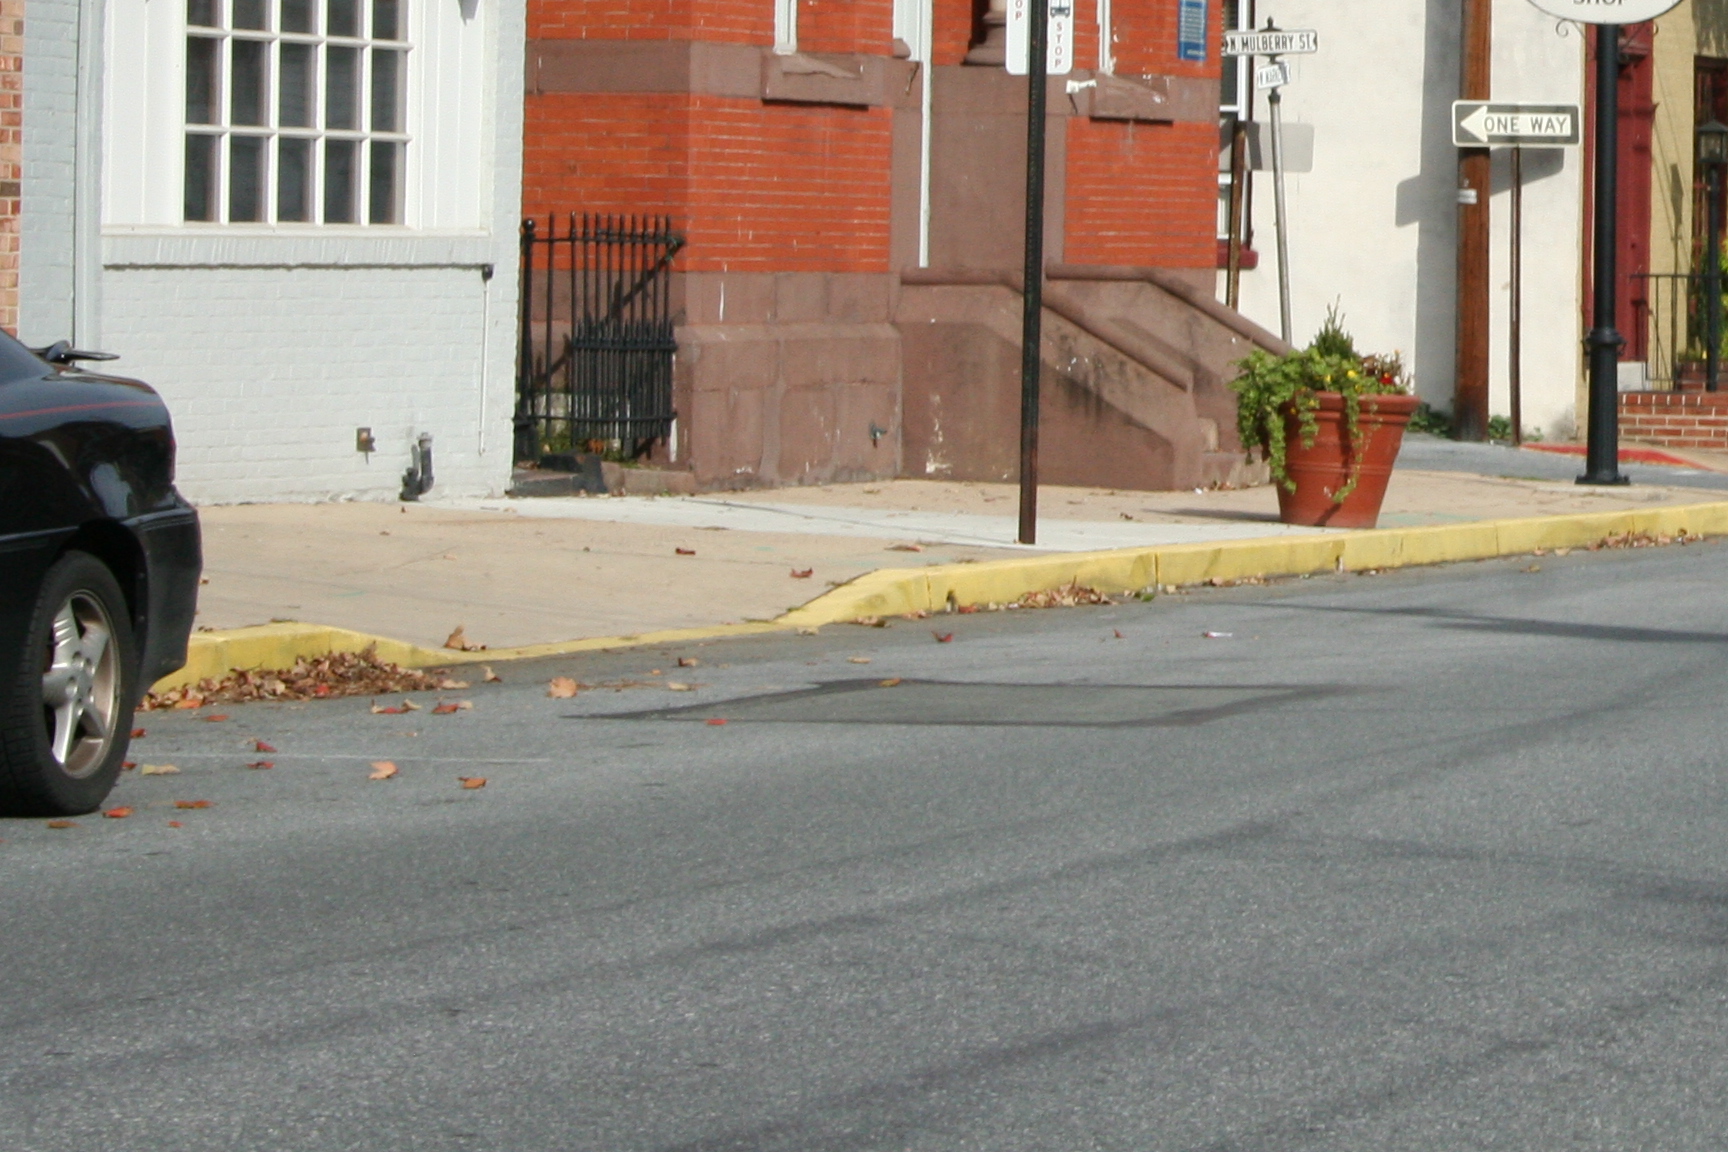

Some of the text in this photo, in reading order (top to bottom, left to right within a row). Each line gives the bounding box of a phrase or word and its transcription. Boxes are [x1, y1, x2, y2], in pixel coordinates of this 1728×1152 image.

[1241, 34, 1294, 51] MULBERRY
[1484, 116, 1567, 133] ONE WAY
